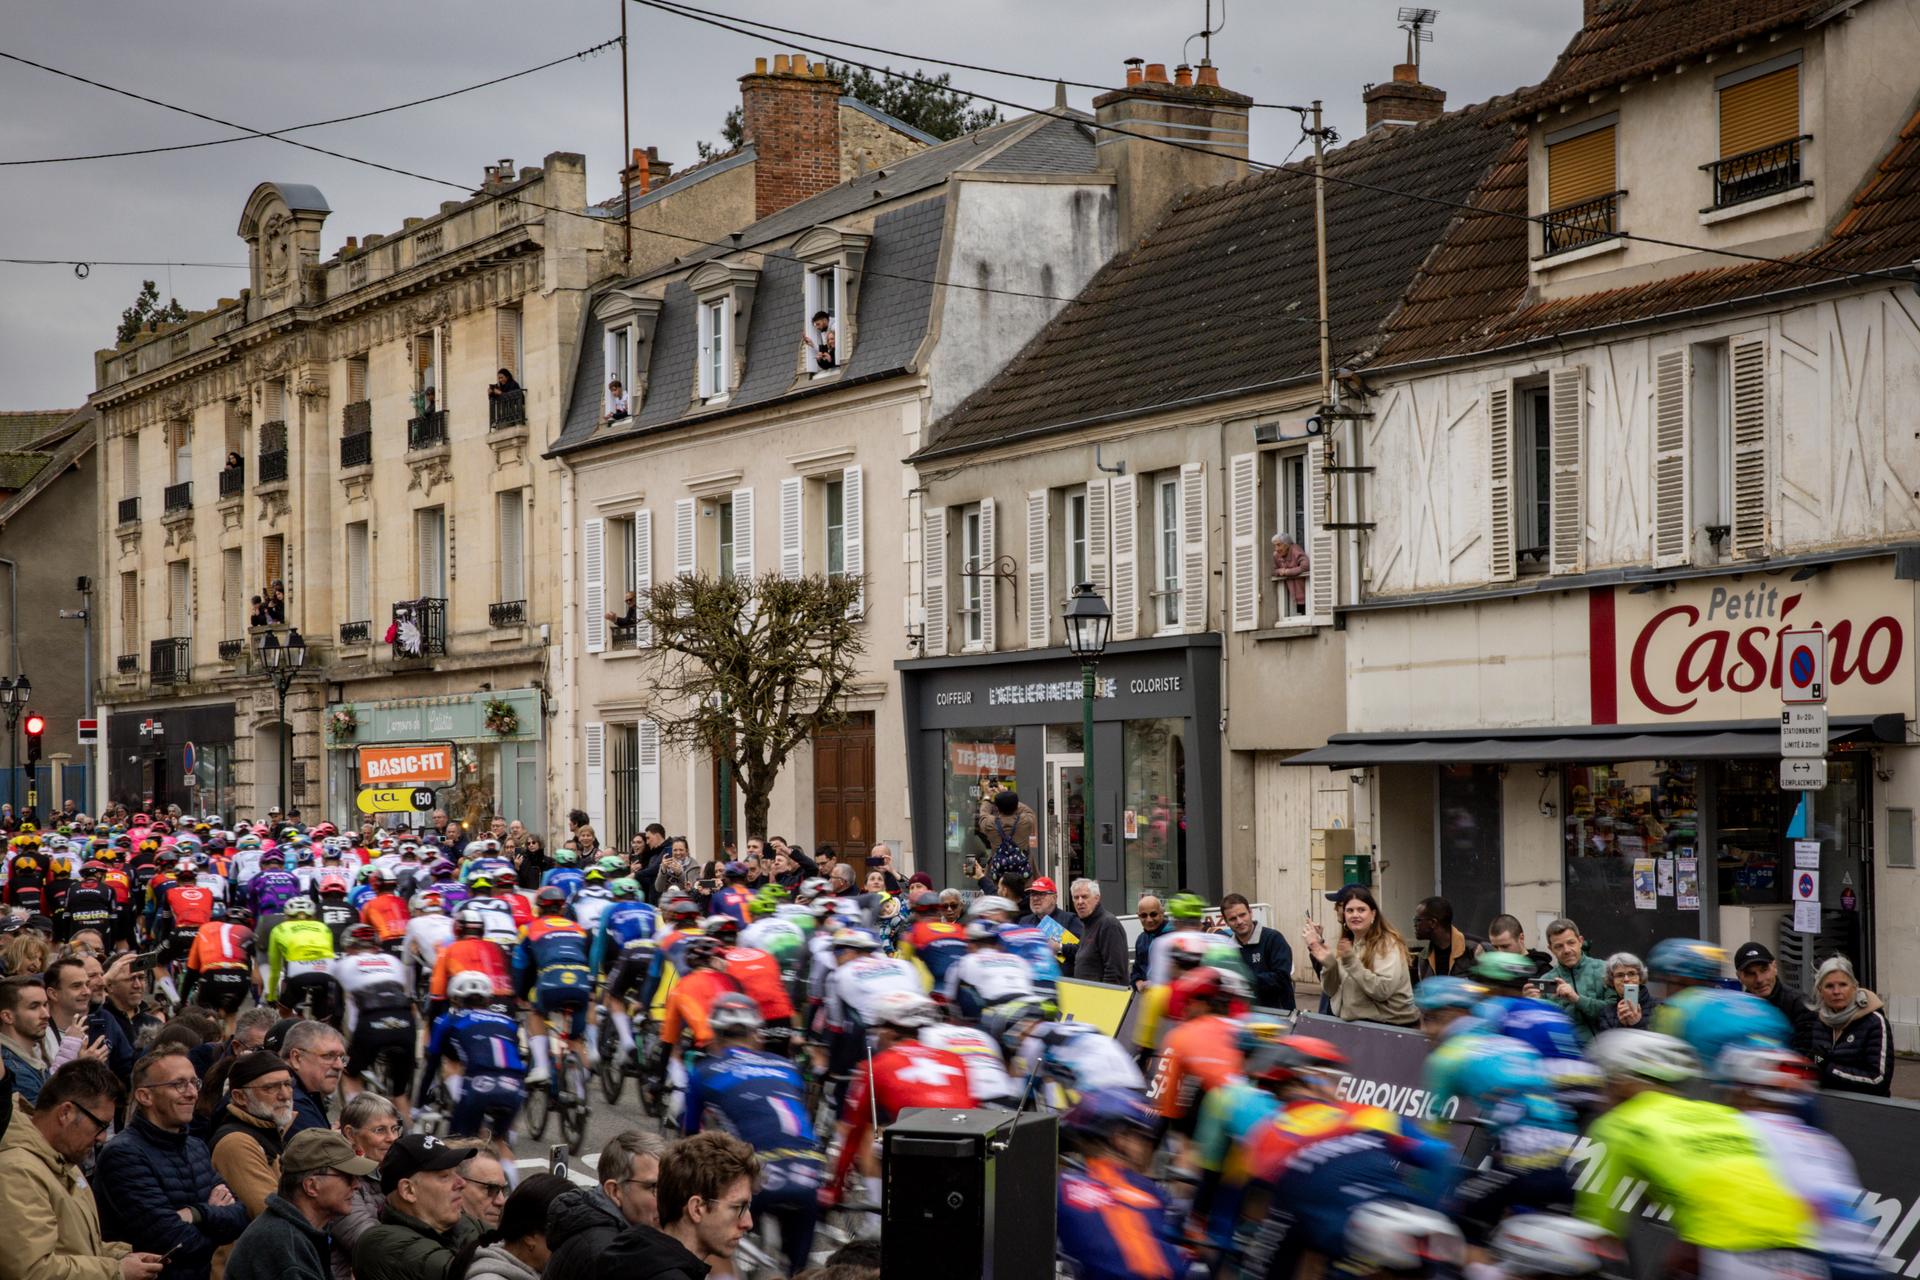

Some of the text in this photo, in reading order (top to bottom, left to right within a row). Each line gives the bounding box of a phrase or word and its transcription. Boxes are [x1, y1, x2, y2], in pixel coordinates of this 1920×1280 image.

[1707, 582, 1779, 621] Petit
[1130, 677, 1181, 694] COLORISTE
[936, 691, 972, 706] COIFFEUR
[1783, 727, 1822, 735] STATIONNEMENT
[1784, 741, 1800, 749] LIMITÉ
[367, 752, 444, 778] BASIC-FIT
[374, 792, 400, 802] LCL
[414, 792, 432, 805] 150
[322, 910, 352, 924] EF
